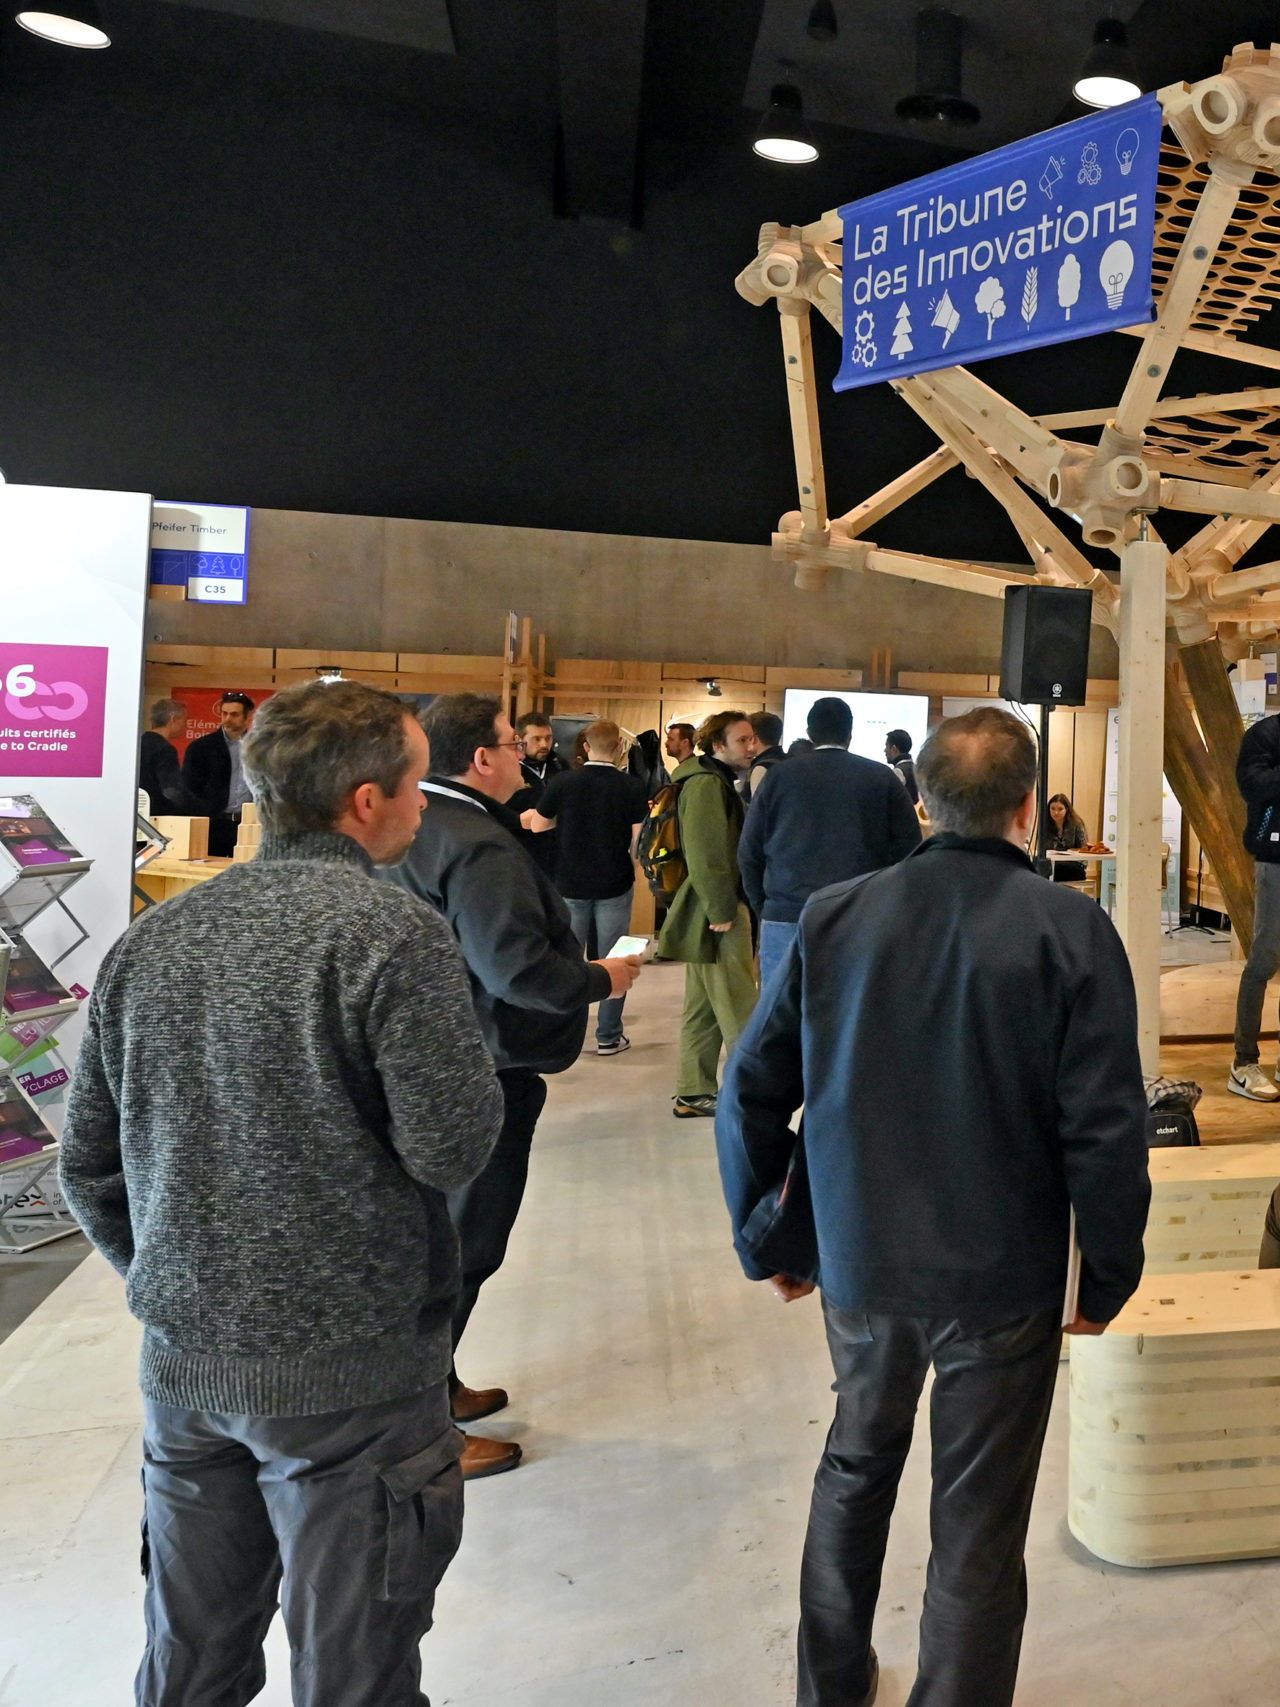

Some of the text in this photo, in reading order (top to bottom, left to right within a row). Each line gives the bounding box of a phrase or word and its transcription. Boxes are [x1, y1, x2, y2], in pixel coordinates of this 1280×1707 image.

[854, 179, 1028, 261] La Tribune
[853, 193, 1138, 306] des Innovations
[152, 522, 228, 535] Pfeifer Timber
[205, 585, 226, 594] C35
[23, 729, 76, 739] certifiés
[11, 742, 24, 751] to
[27, 741, 68, 751] Cradle
[1156, 1125, 1178, 1135] etchart
